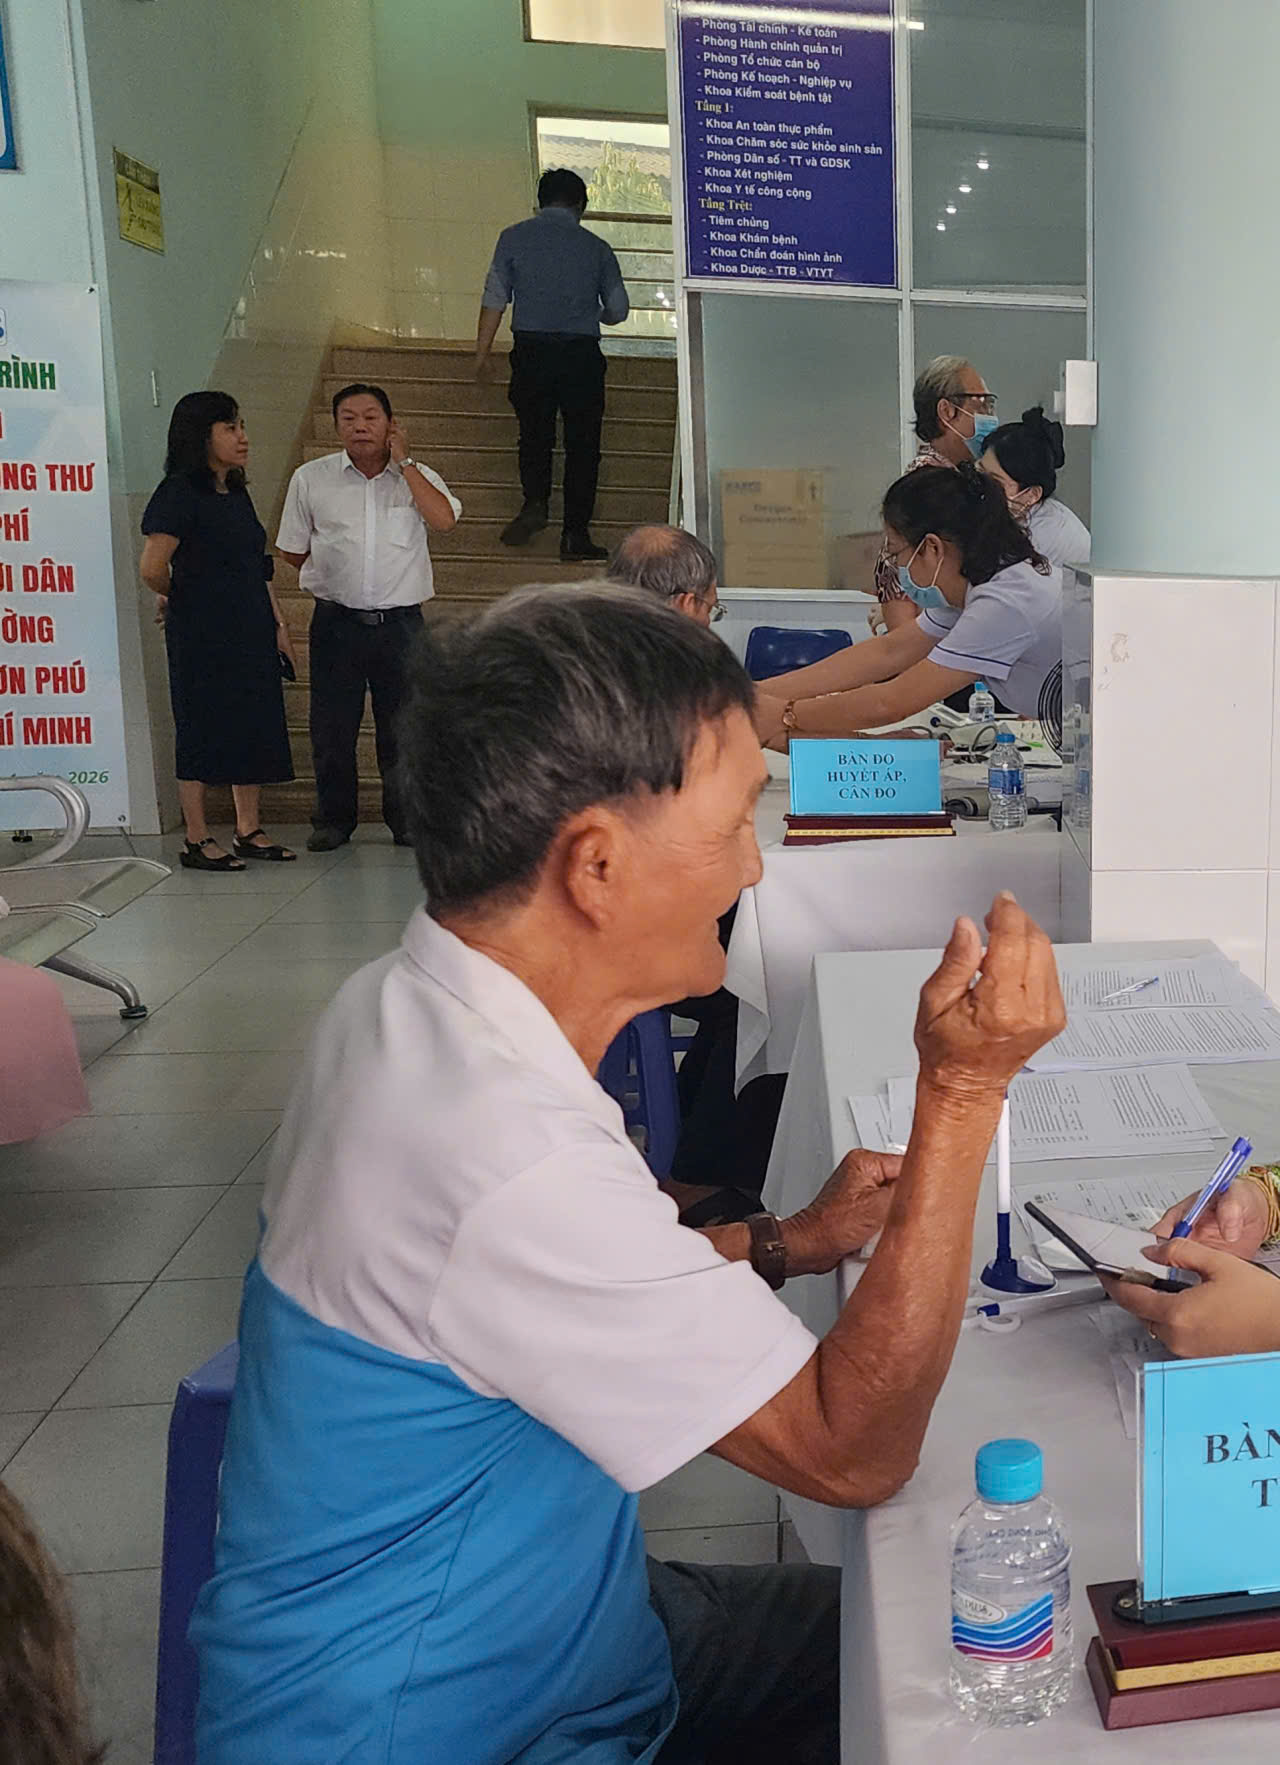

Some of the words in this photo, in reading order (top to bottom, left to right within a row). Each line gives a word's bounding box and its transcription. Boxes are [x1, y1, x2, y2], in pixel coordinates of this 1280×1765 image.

[702, 18, 736, 33] Phòng
[814, 27, 838, 38] toán
[703, 35, 737, 49] Phòng
[740, 38, 767, 49] Hành
[770, 40, 800, 52] chính
[803, 42, 829, 55] quản
[831, 45, 843, 57] trị
[703, 52, 738, 66] Phòng
[740, 53, 755, 65] Tổ
[757, 56, 782, 67] chức
[785, 58, 804, 68] cán
[806, 59, 820, 71] bộ
[704, 68, 738, 83] Phòng
[741, 70, 756, 82] Kế
[758, 72, 790, 85] hoạch
[799, 75, 837, 89] Nghiệp
[839, 80, 853, 90] vụ
[704, 85, 732, 97] Khoa
[735, 85, 762, 98] Kiểm
[764, 89, 787, 100] soát
[789, 90, 816, 103] bệnh
[818, 93, 833, 104] tật
[706, 118, 733, 130] Khoa
[735, 120, 750, 130] An
[753, 121, 776, 132] toàn
[778, 123, 802, 135] thực
[804, 122, 833, 136] phẩm
[706, 134, 734, 146] Khoa
[736, 136, 767, 148] Chăm
[769, 138, 788, 149] sóc
[790, 139, 809, 150] sức
[839, 142, 862, 154] sinh
[863, 143, 883, 155] sản
[706, 150, 741, 165] Phòng
[743, 152, 764, 163] Dân
[766, 153, 780, 164] số
[788, 155, 802, 166] TT
[805, 157, 818, 167] và
[820, 157, 851, 169] GDSK
[704, 166, 732, 178] Khoa
[734, 168, 752, 179] Xét
[754, 170, 793, 183] nghiệm
[705, 182, 732, 193] Khoa
[735, 184, 742, 194] Y
[744, 184, 756, 195] tế
[757, 186, 784, 199] công
[785, 187, 812, 200] cộng
[709, 215, 734, 226] Tiêm
[736, 216, 770, 230] chủng
[709, 231, 737, 242] Khoa
[739, 232, 769, 243] Khám
[772, 234, 798, 246] bệnh
[710, 246, 737, 257] Khoa
[740, 246, 767, 259] Chẩn
[769, 250, 795, 260] đoán
[797, 251, 821, 262] hình
[823, 251, 843, 263] ảnh
[711, 262, 738, 273] Khoa
[740, 264, 767, 276] Dược
[775, 265, 797, 276] TTB
[806, 267, 834, 278] VTYT
[0, 354, 56, 390] RÌNH
[45, 462, 95, 491] THƯ
[22, 557, 74, 593] DÂN
[1, 607, 54, 644] ỜNG
[35, 659, 86, 695] PHÚ
[22, 716, 92, 745] MINH
[838, 751, 868, 765] BÀN
[873, 753, 895, 765] ĐO
[68, 771, 109, 784] 2026
[827, 768, 880, 782] HUYẾT
[883, 767, 907, 782] ÁP,
[839, 784, 870, 799] CÂN
[875, 787, 896, 799] ĐO
